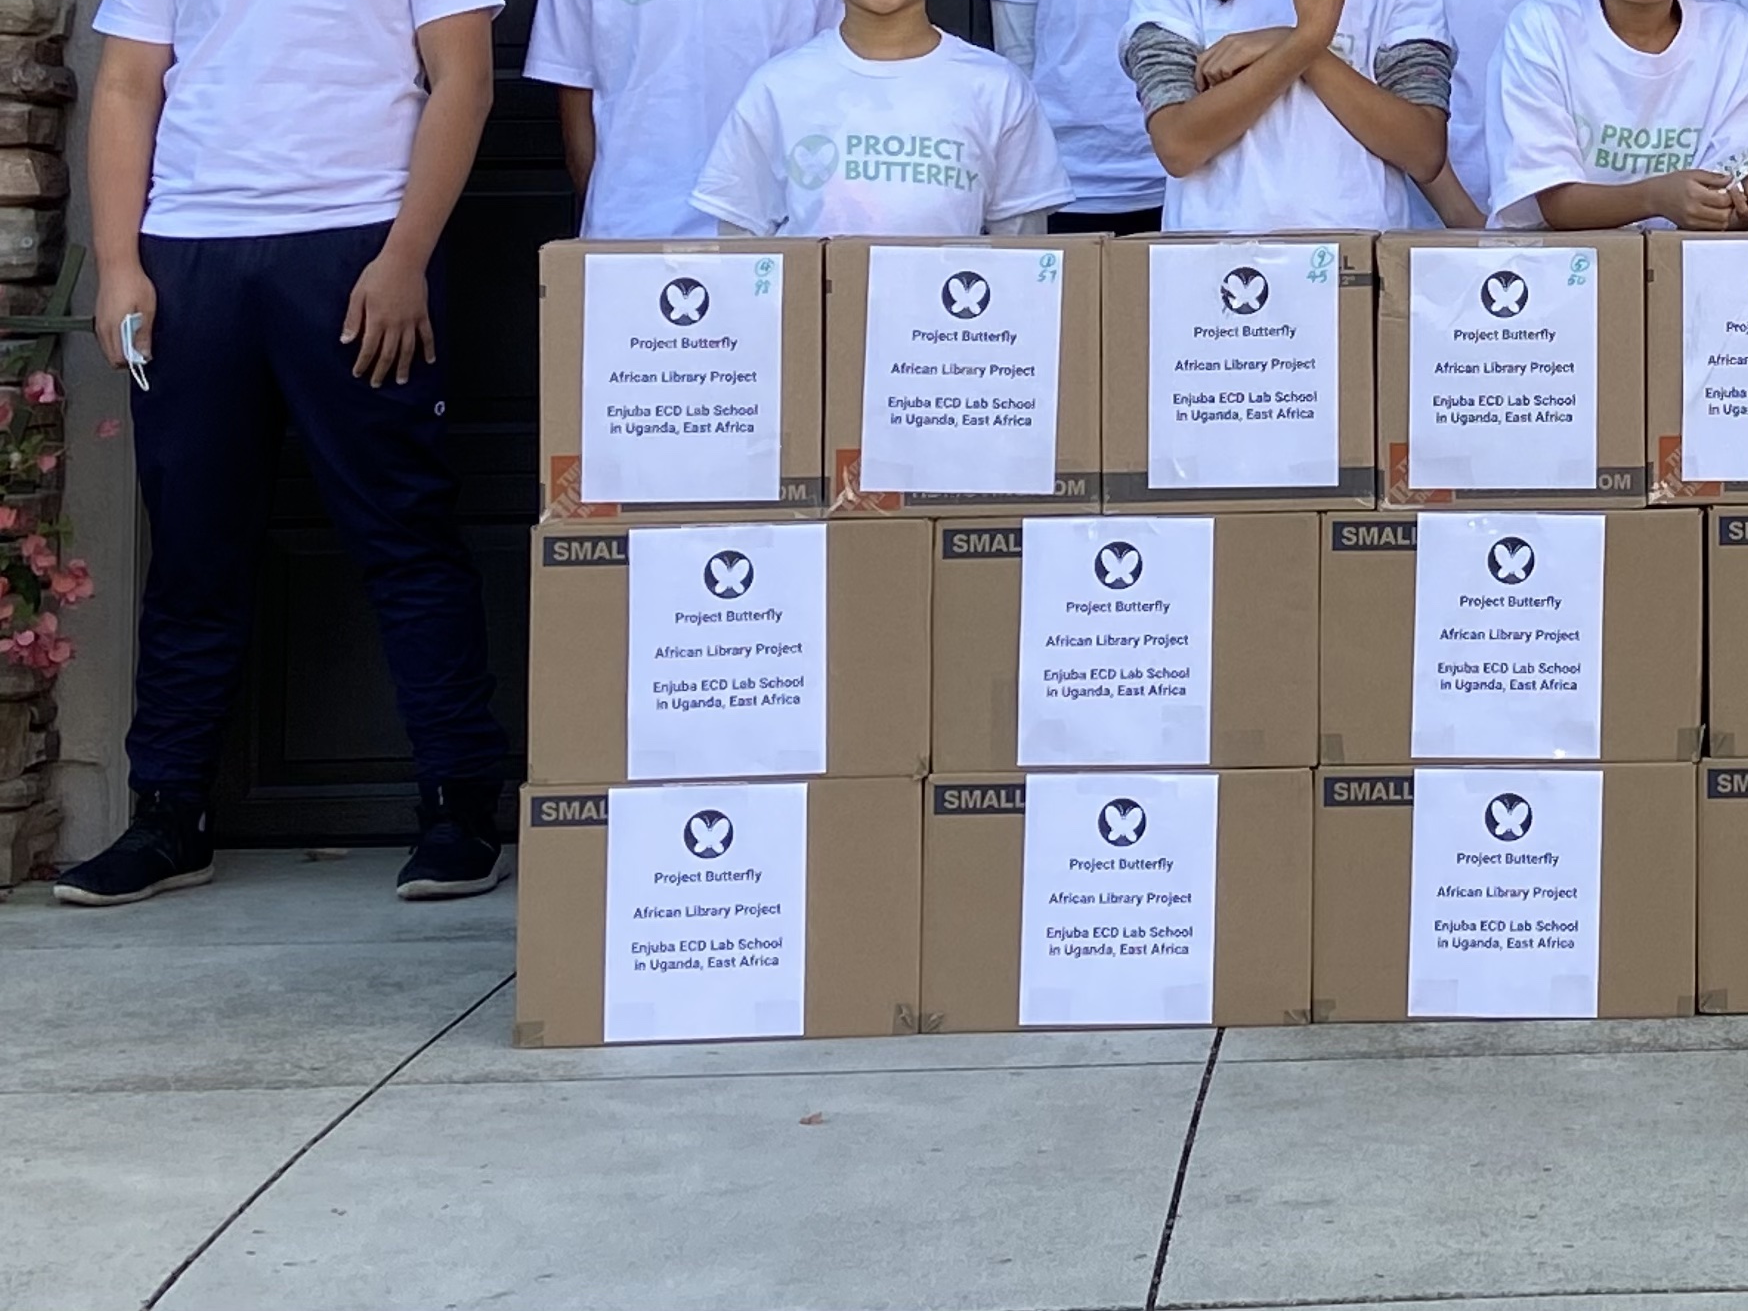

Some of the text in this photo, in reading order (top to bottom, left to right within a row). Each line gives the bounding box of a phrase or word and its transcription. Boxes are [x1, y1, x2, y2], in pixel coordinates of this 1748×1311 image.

[1601, 124, 1702, 150] PROJECT
[846, 134, 965, 162] PROJECT
[845, 160, 979, 192] BUTTERFLY
[631, 337, 737, 351] Project Butterfly
[1454, 329, 1556, 343] Project Butterfly
[1435, 362, 1574, 376] African Library Project
[609, 371, 756, 385] African Library Project
[1433, 394, 1575, 409] Enjuba ECD Lab School
[607, 404, 758, 419] Enjuba ECD Lab School
[1436, 411, 1572, 425] in Uganda, East Africa
[610, 421, 754, 437] in Uganda, East Africa
[553, 541, 625, 561] SMAL
[952, 533, 1022, 553] SMAL
[1067, 600, 1170, 615] Project Butterfly
[1046, 634, 1188, 648] African Library Project
[1044, 667, 1190, 683] Enjuba ECD Lab School
[1047, 684, 1186, 700] in Uganda, East Africa
[943, 789, 1025, 809] SMALL
[1333, 781, 1414, 801] SMALL
[541, 801, 609, 821] SMAL
[654, 869, 762, 886] Project Butterfly
[633, 904, 780, 919] African Library Project
[632, 937, 782, 956] Enjuba ECD Lab School
[635, 955, 779, 973] in Uganda, East Africa
